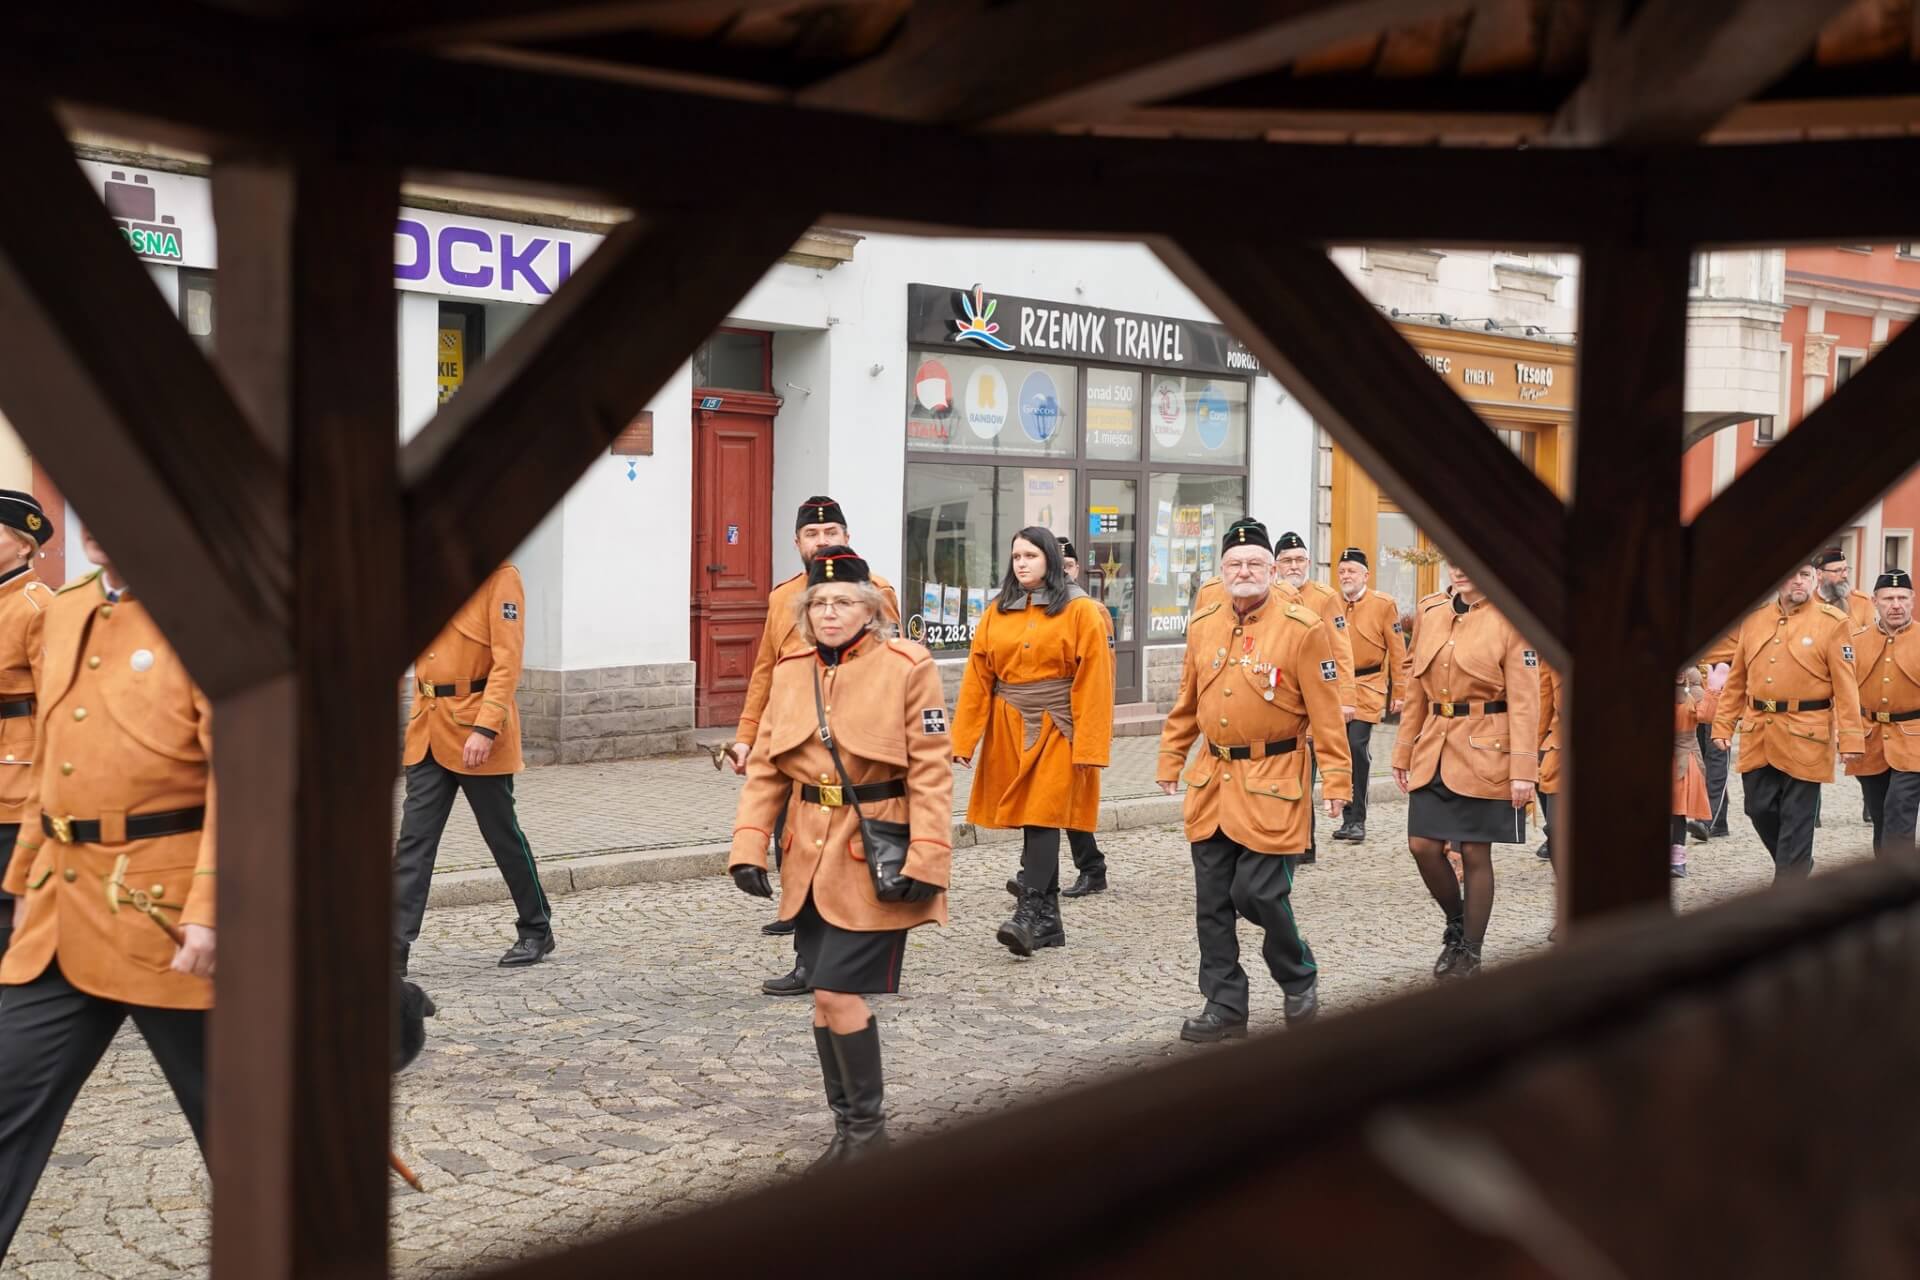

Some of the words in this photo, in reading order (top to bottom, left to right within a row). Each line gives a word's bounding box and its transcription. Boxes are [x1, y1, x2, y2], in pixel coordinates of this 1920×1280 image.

[119, 227, 180, 257] SNA
[1020, 306, 1106, 354] RZEMYK
[1114, 317, 1184, 362] TRAVEL
[1464, 367, 1486, 385] RYNEK
[1486, 370, 1494, 386] 14
[1515, 362, 1553, 387] TESORO
[1087, 384, 1112, 401] onad
[1114, 385, 1133, 402] 500
[968, 412, 1004, 425] RAINBOW
[1093, 430, 1099, 444] 1
[1101, 431, 1133, 447] miejscu
[927, 626, 943, 643] 32
[945, 624, 967, 643] 282
